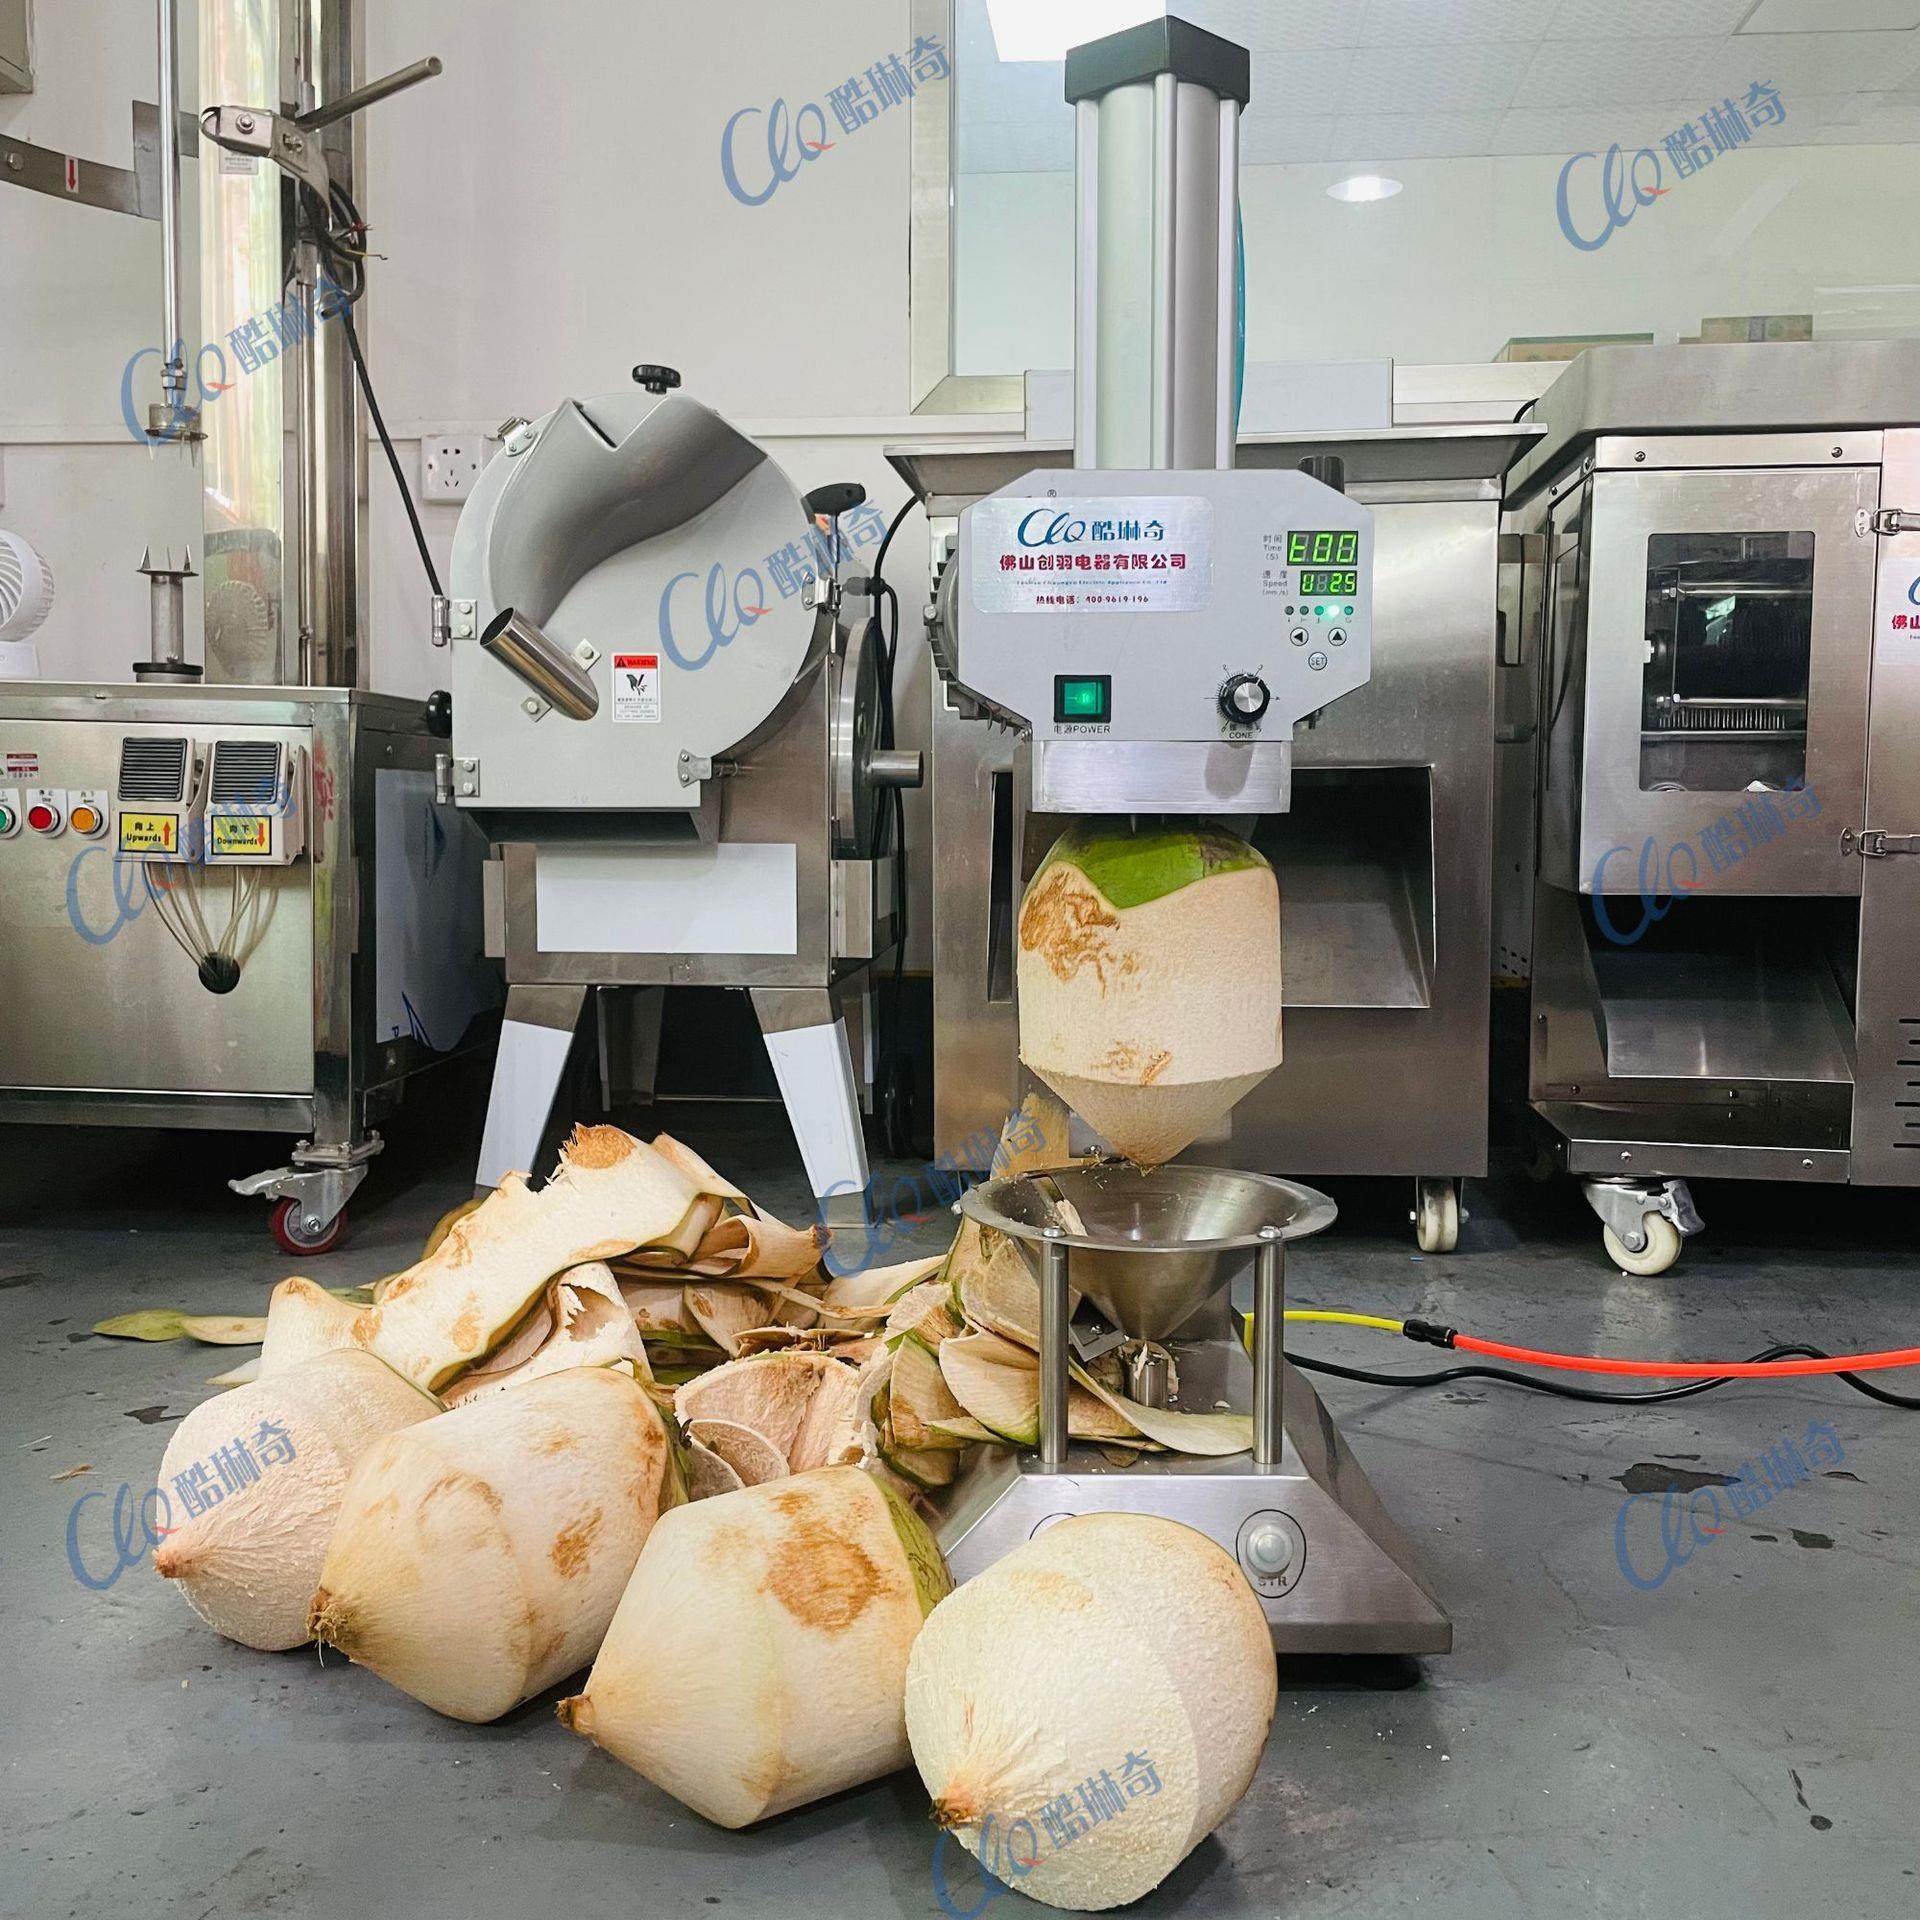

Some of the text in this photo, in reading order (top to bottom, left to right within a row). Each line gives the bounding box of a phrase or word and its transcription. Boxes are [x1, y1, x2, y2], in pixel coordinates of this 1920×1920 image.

[1091, 520, 1167, 541] 酷琳奇
[1000, 554, 1186, 570] 佛山创羽电器有限公司
[1262, 580, 1288, 589] Speed
[1311, 657, 1325, 666] SET
[1229, 731, 1253, 739] CONE
[126, 833, 161, 843] Upwards
[217, 837, 257, 845] Downwards
